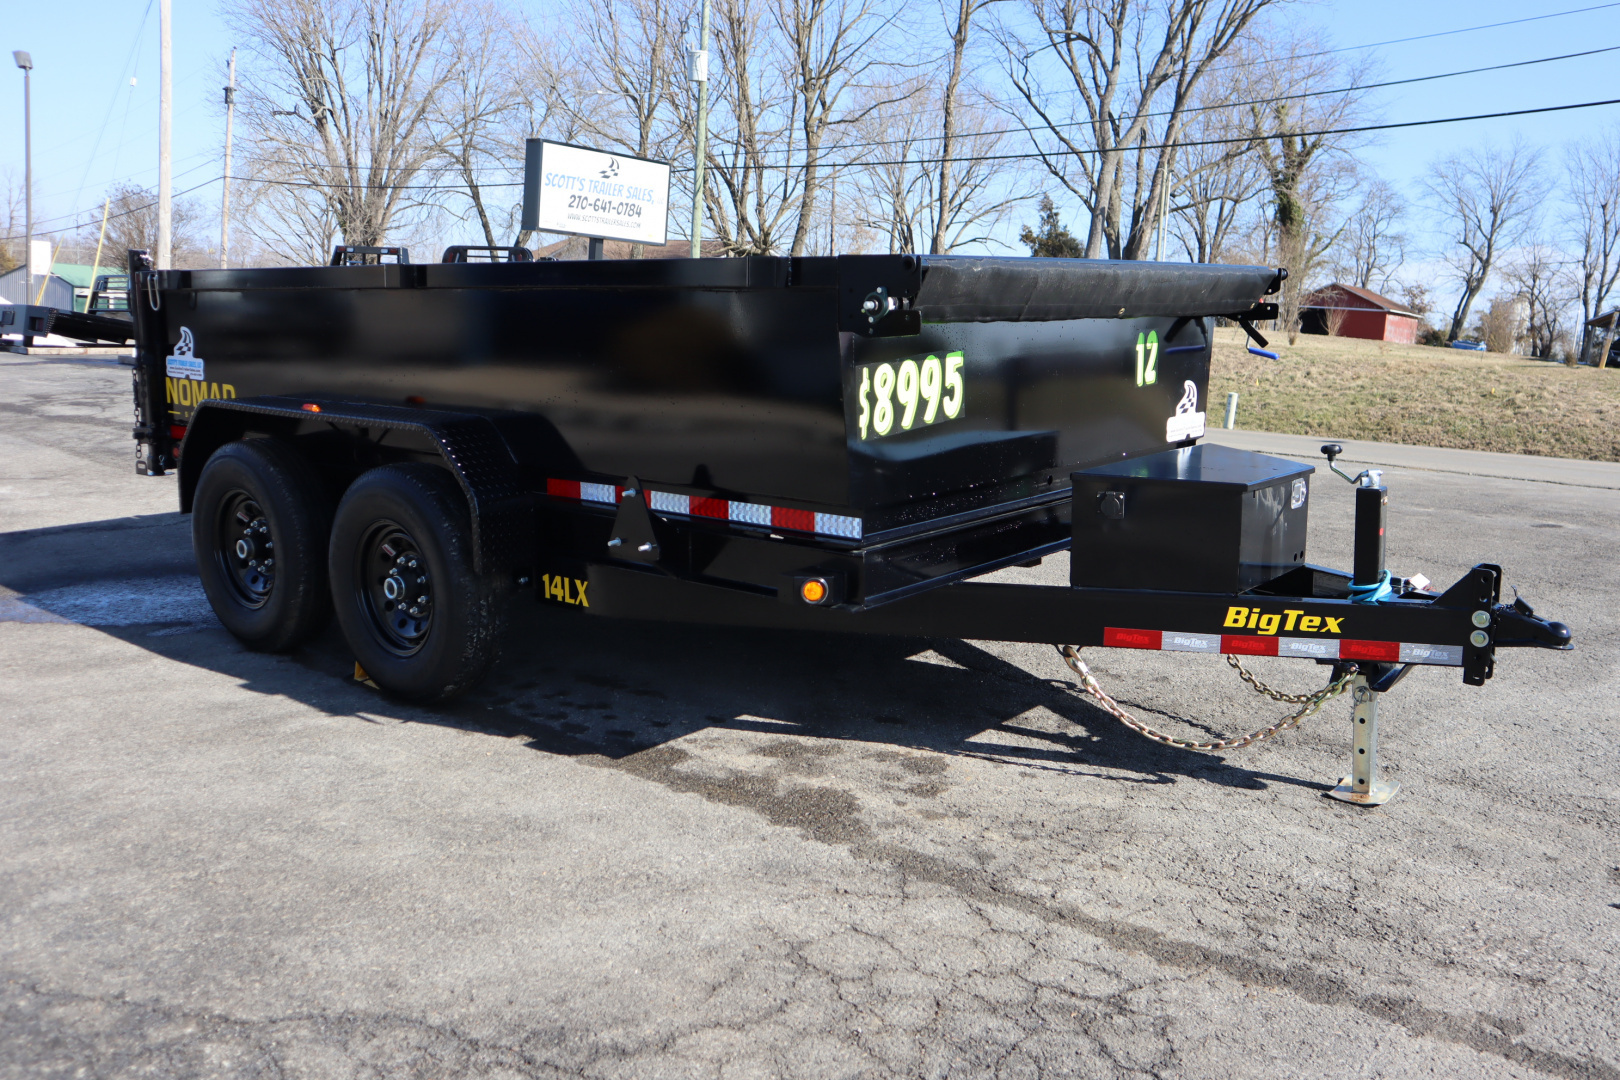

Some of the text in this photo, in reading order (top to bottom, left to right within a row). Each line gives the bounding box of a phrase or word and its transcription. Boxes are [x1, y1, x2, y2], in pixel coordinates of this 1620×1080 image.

[545, 173, 585, 191] SCOTT'S
[588, 180, 624, 197] TRAILER
[626, 186, 654, 205] SALES,
[567, 194, 642, 218] 270-641-0784
[1135, 330, 1159, 387] 12
[165, 377, 235, 407] NOMAD
[859, 350, 964, 440] $8995
[542, 573, 589, 607] 14LX
[1223, 606, 1345, 635] BigTex
[1173, 637, 1208, 648] BigTex
[1412, 648, 1449, 659] BigTex
